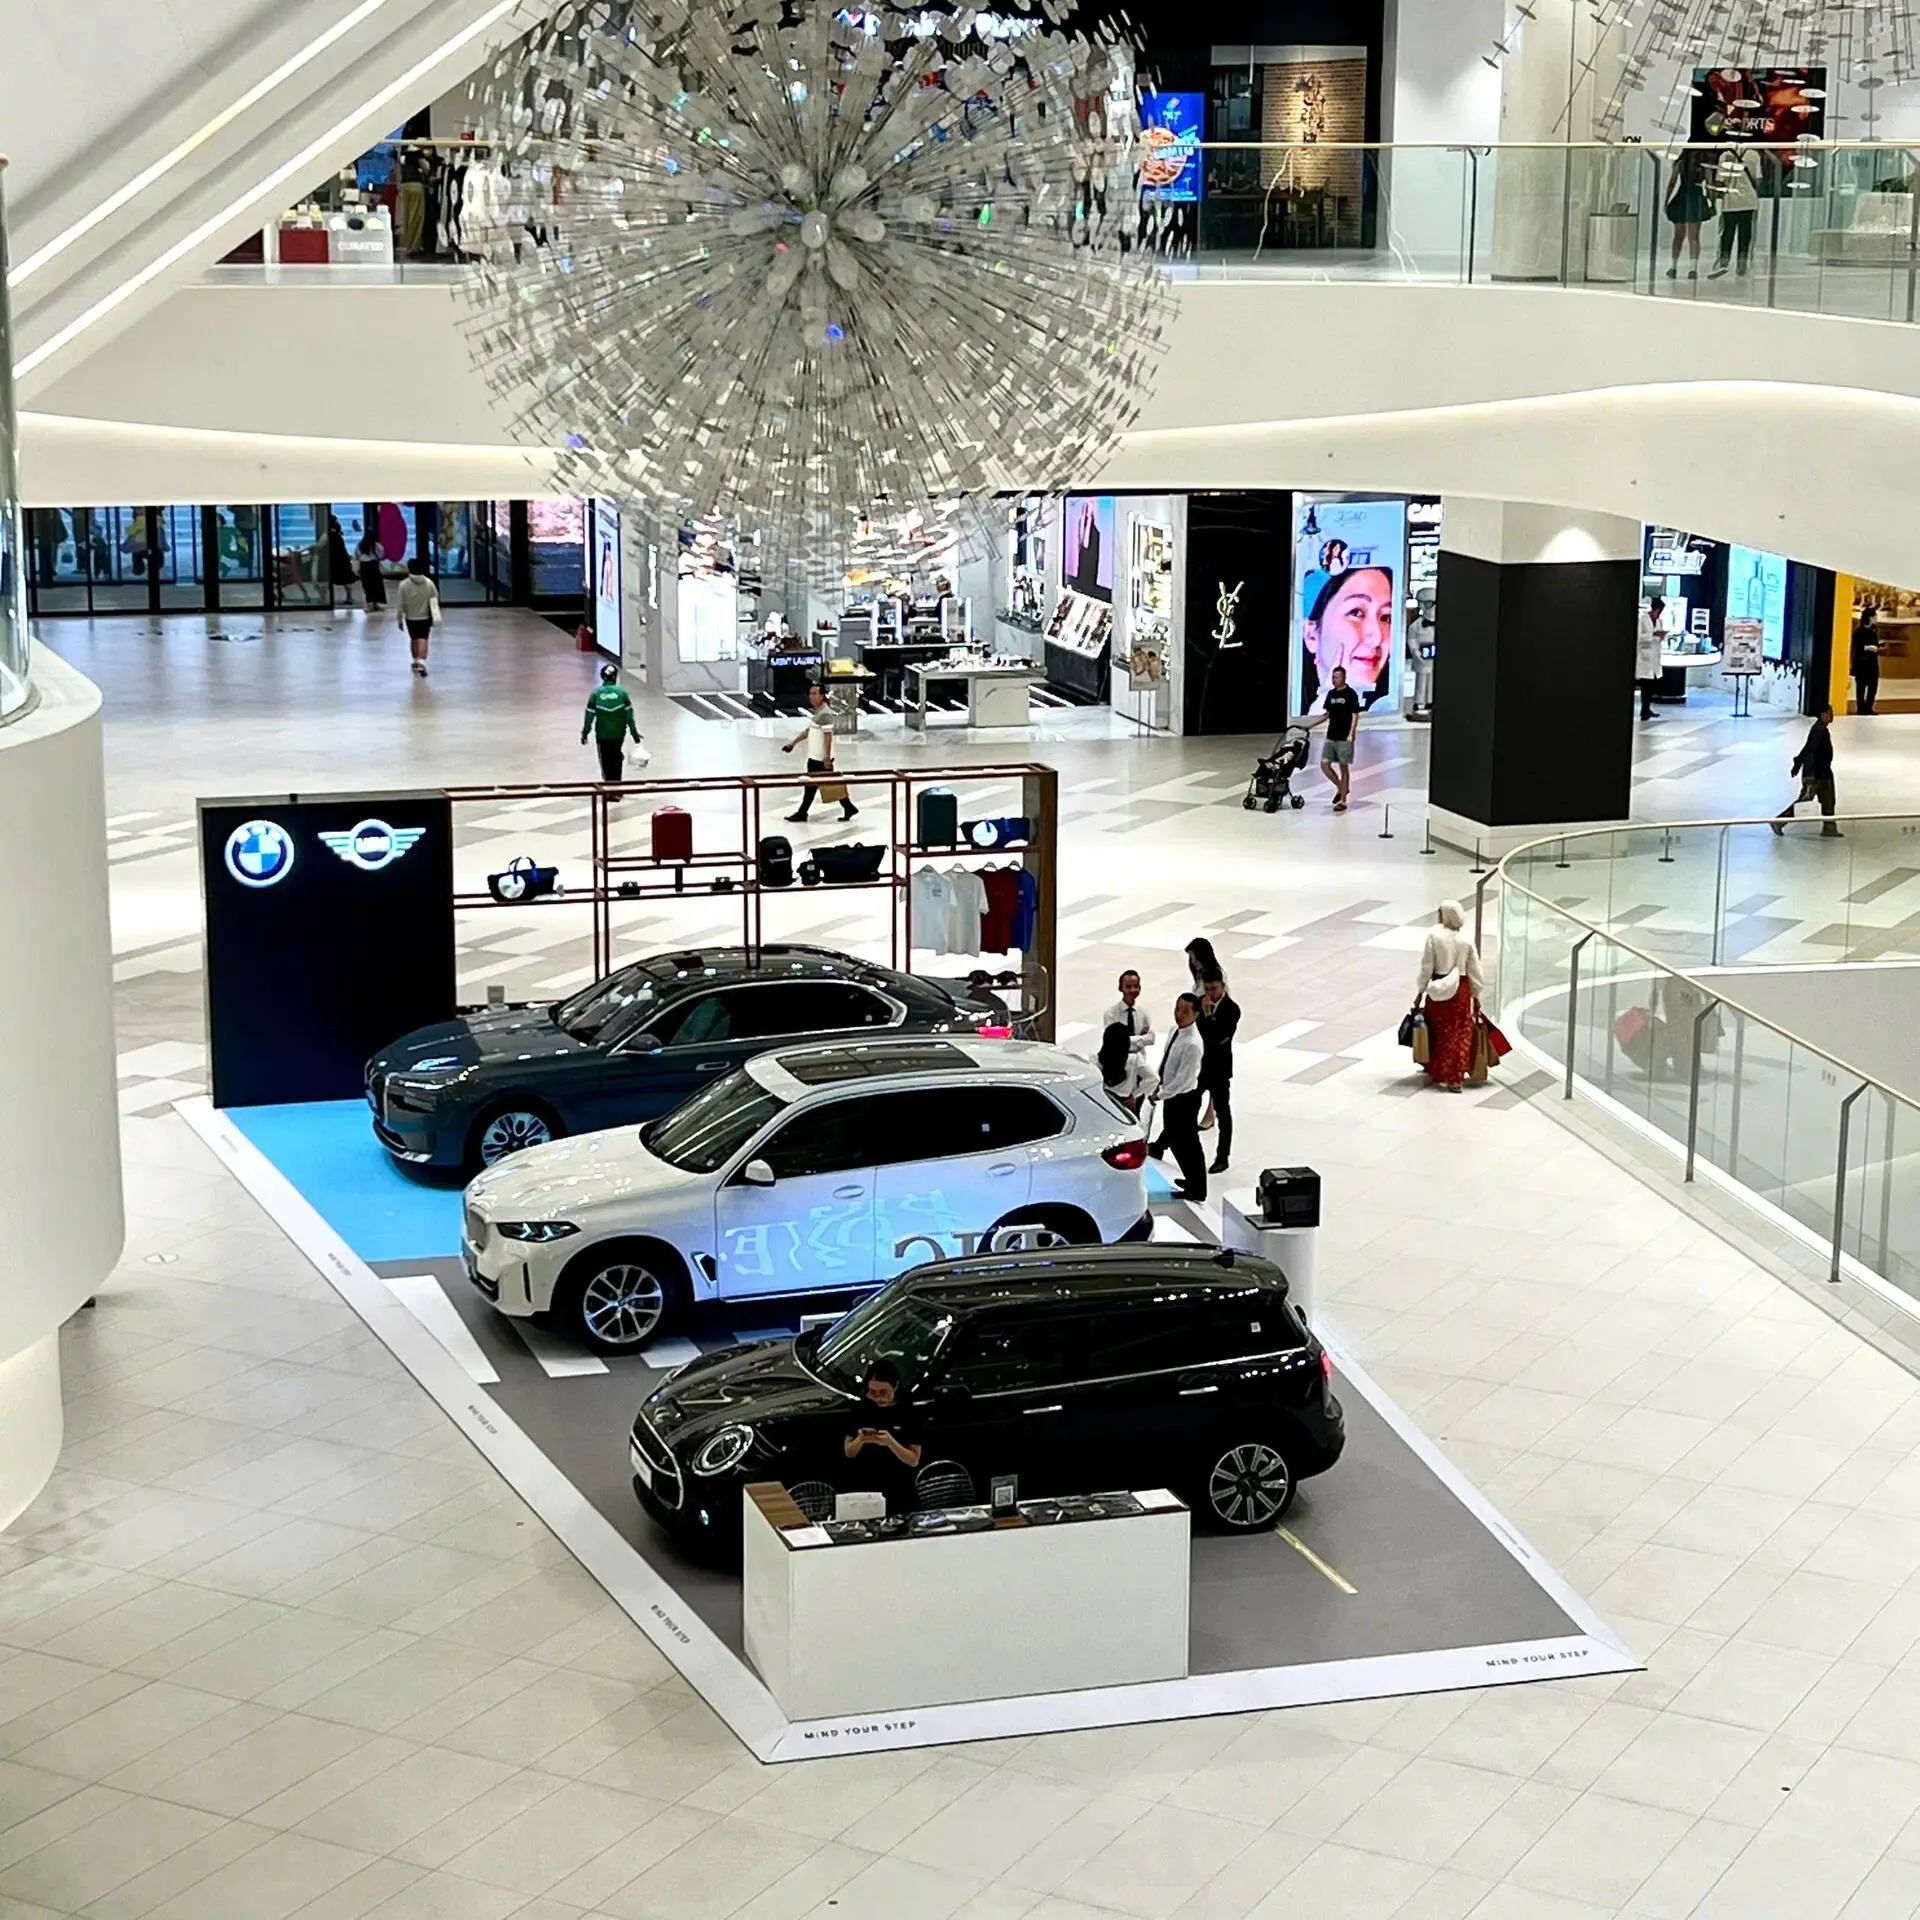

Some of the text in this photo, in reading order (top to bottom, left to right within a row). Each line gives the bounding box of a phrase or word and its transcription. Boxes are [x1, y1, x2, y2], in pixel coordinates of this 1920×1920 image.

[1485, 1649, 1589, 1667] MIND YOUR STEP
[804, 1720, 916, 1740] MIND YOUR STEP
